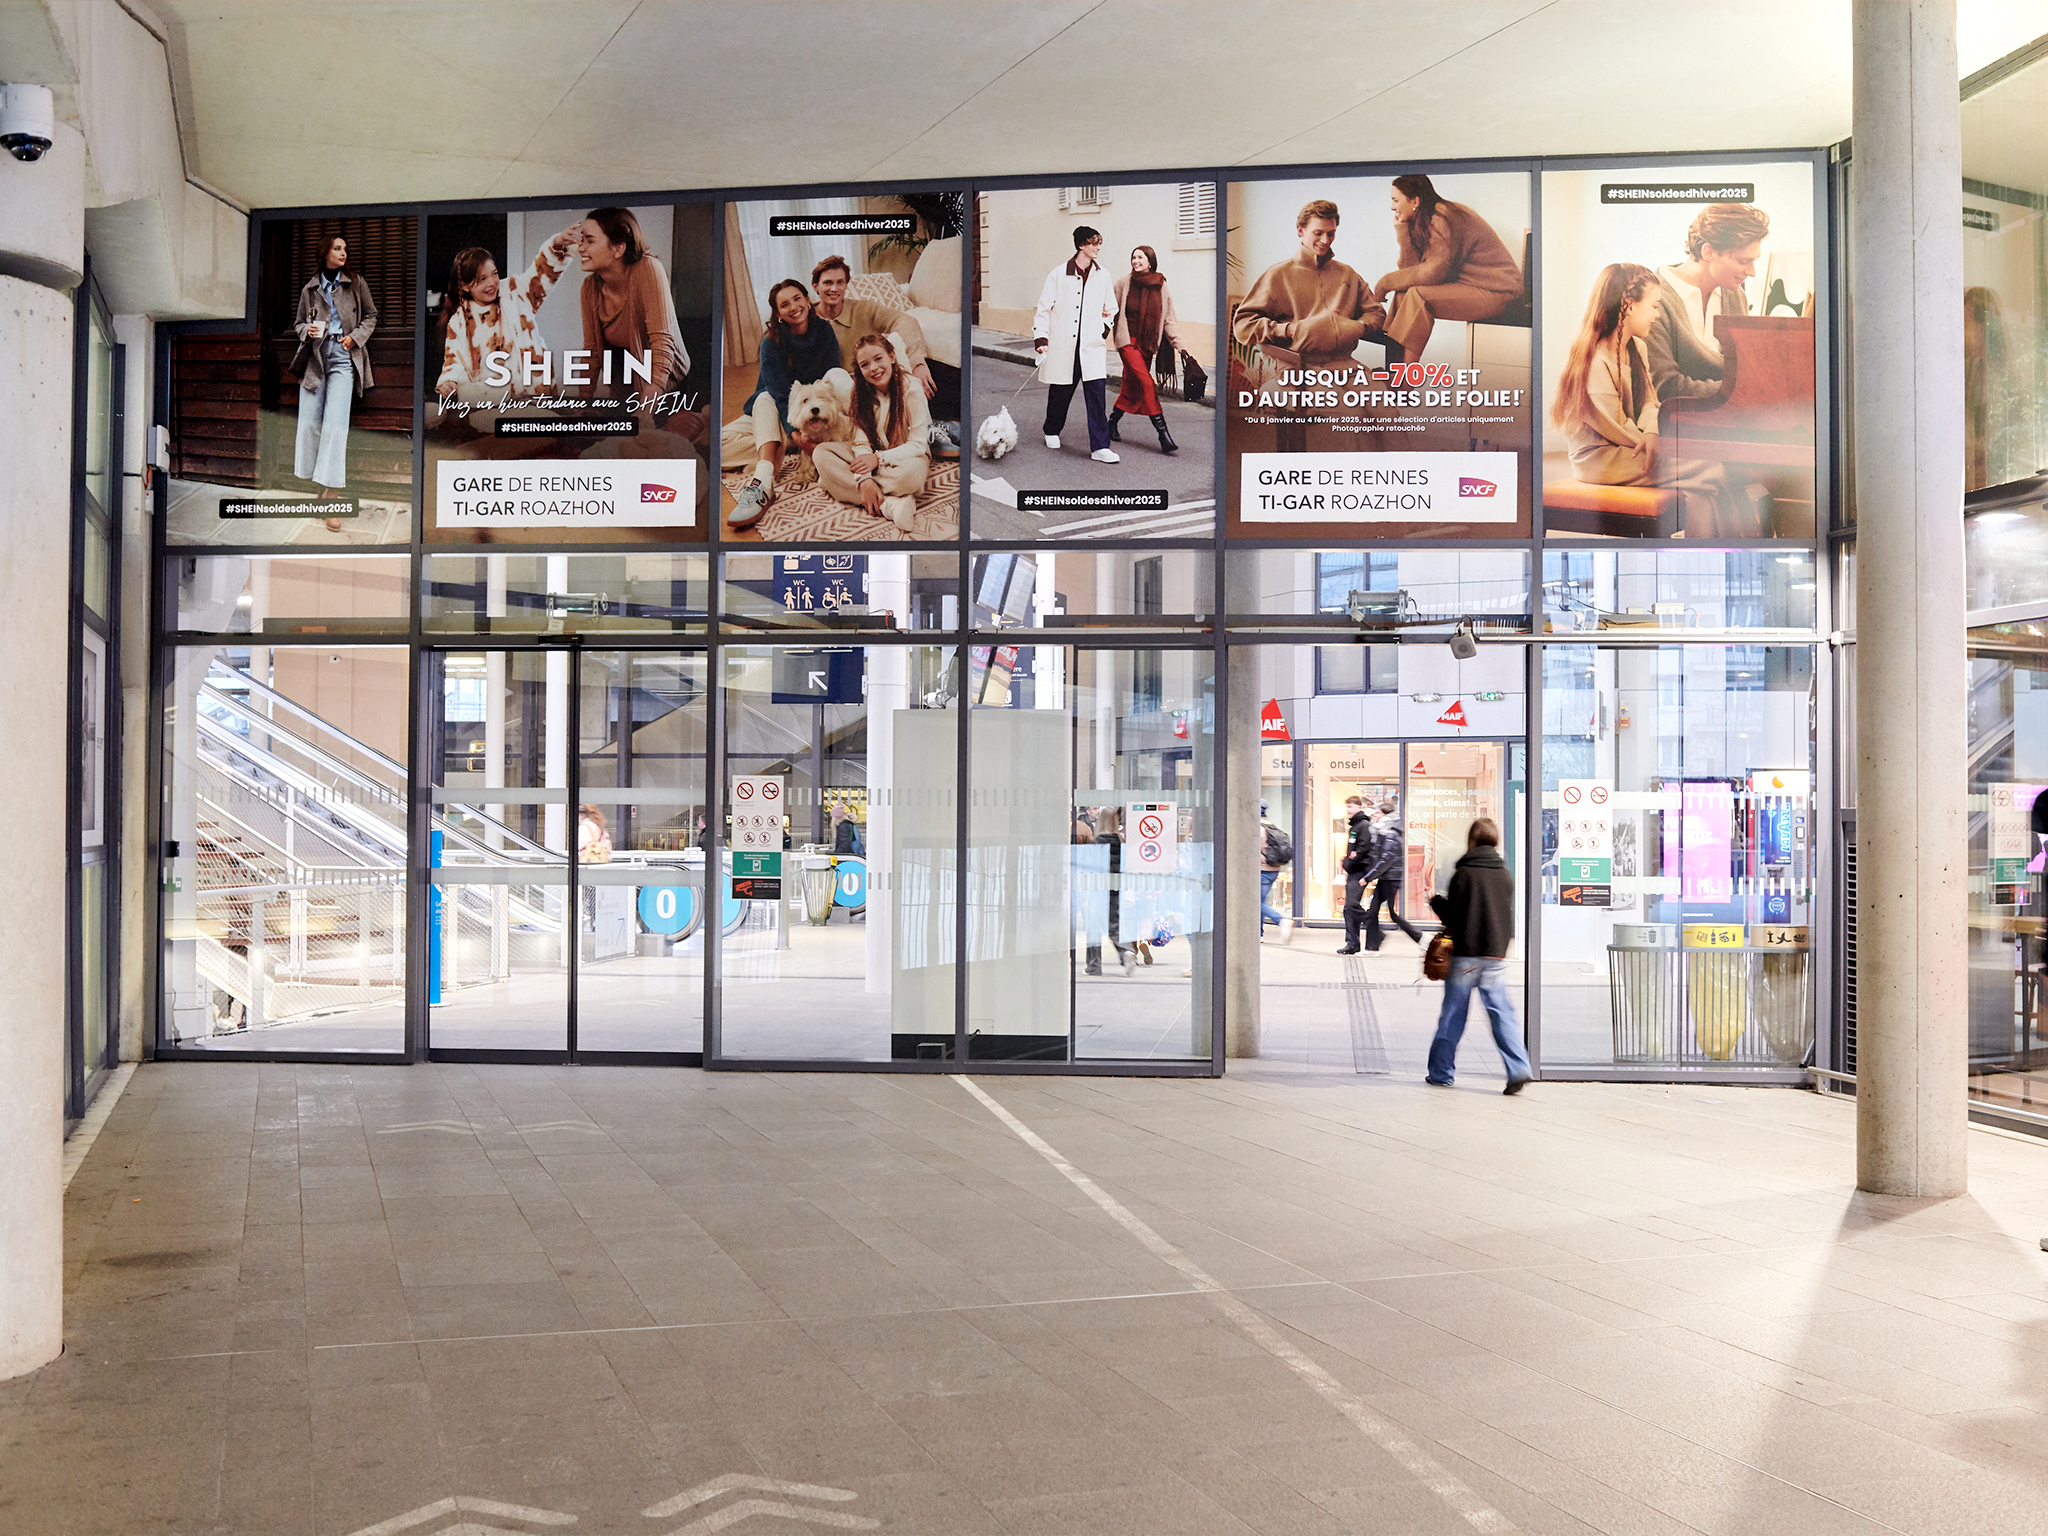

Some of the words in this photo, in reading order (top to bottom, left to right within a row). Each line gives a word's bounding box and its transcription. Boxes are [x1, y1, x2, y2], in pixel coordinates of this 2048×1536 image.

[1608, 188, 1748, 199] #SHEINsoldesdhiver2025
[776, 219, 910, 231] #SHEINsoldesdhiver2025
[484, 349, 652, 387] SHEIN
[1277, 364, 1368, 387] JUSQU'À
[1457, 369, 1481, 386] ET
[438, 389, 470, 418] Vivez
[476, 400, 494, 410] un
[498, 390, 532, 414] hiver
[532, 390, 587, 409] tendance
[592, 399, 620, 408] avec
[625, 391, 698, 416] SHEIN
[1238, 390, 1338, 408] D'AUTRES
[1342, 390, 1420, 408] OFFRES
[1426, 390, 1450, 408] DE
[1260, 416, 1265, 424] 8
[1266, 416, 1294, 424] janvier
[1307, 416, 1312, 424] 4
[1314, 416, 1340, 424] février
[1340, 416, 1362, 424] 2025,
[1394, 416, 1428, 424] sélection
[1430, 416, 1466, 424] d'articles
[1467, 416, 1514, 424] uniquement
[501, 422, 632, 433] #SHEINsoldesdhiver2025
[1332, 425, 1384, 433] Photographie
[453, 478, 502, 492] GARE
[509, 477, 532, 492] DE
[540, 476, 612, 492] RENNES
[1258, 470, 1312, 486] GARE
[1318, 470, 1343, 485] DE
[1351, 470, 1428, 485] RENNES
[642, 490, 675, 500] SNCF
[1460, 485, 1496, 496] SNCF
[1024, 495, 1161, 506] #SHEINsoldesdhiver2025
[1258, 494, 1325, 510] TI-GAR
[1331, 494, 1431, 510] ROAZHON
[226, 503, 352, 514] #SHEINsoldesdhiver2025
[453, 501, 514, 516] TI-GAR
[520, 500, 614, 515] ROAZHON
[832, 578, 844, 586] WC
[1441, 712, 1464, 721] MAIF
[843, 872, 858, 896] 0
[656, 889, 676, 918] 0
